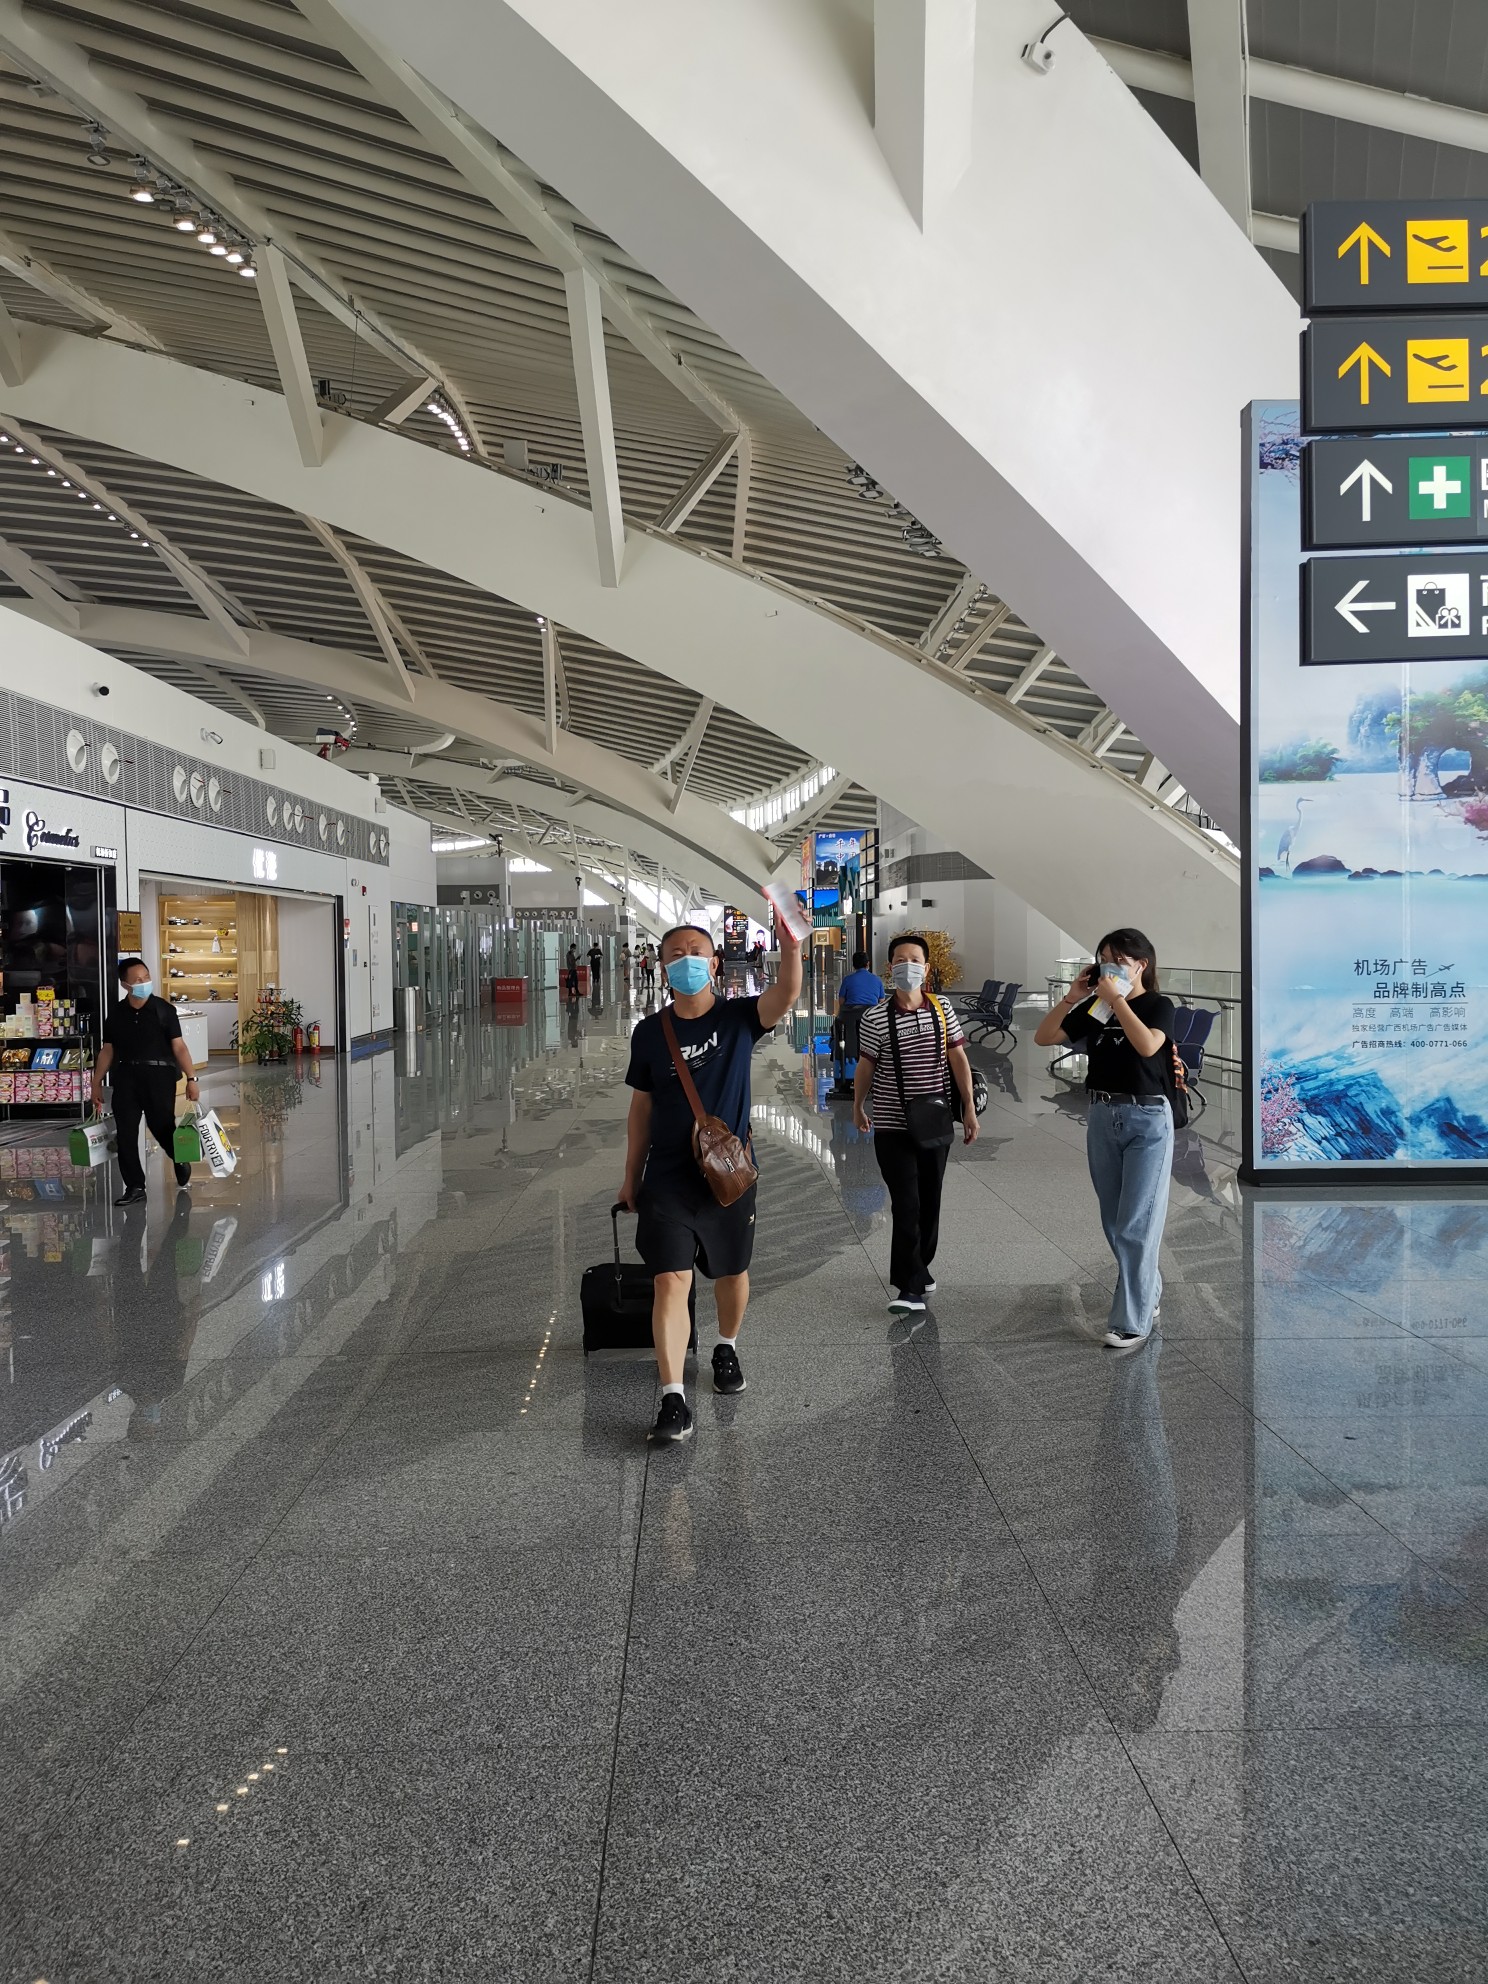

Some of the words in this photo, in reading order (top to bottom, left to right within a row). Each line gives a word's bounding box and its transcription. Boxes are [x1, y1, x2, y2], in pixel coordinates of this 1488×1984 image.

[1353, 958, 1428, 976] 机场广告
[1373, 981, 1466, 999] 品牌制高点
[1352, 1007, 1376, 1018] 高度
[1389, 1007, 1414, 1018] 高端
[1429, 1006, 1466, 1018] 高影响
